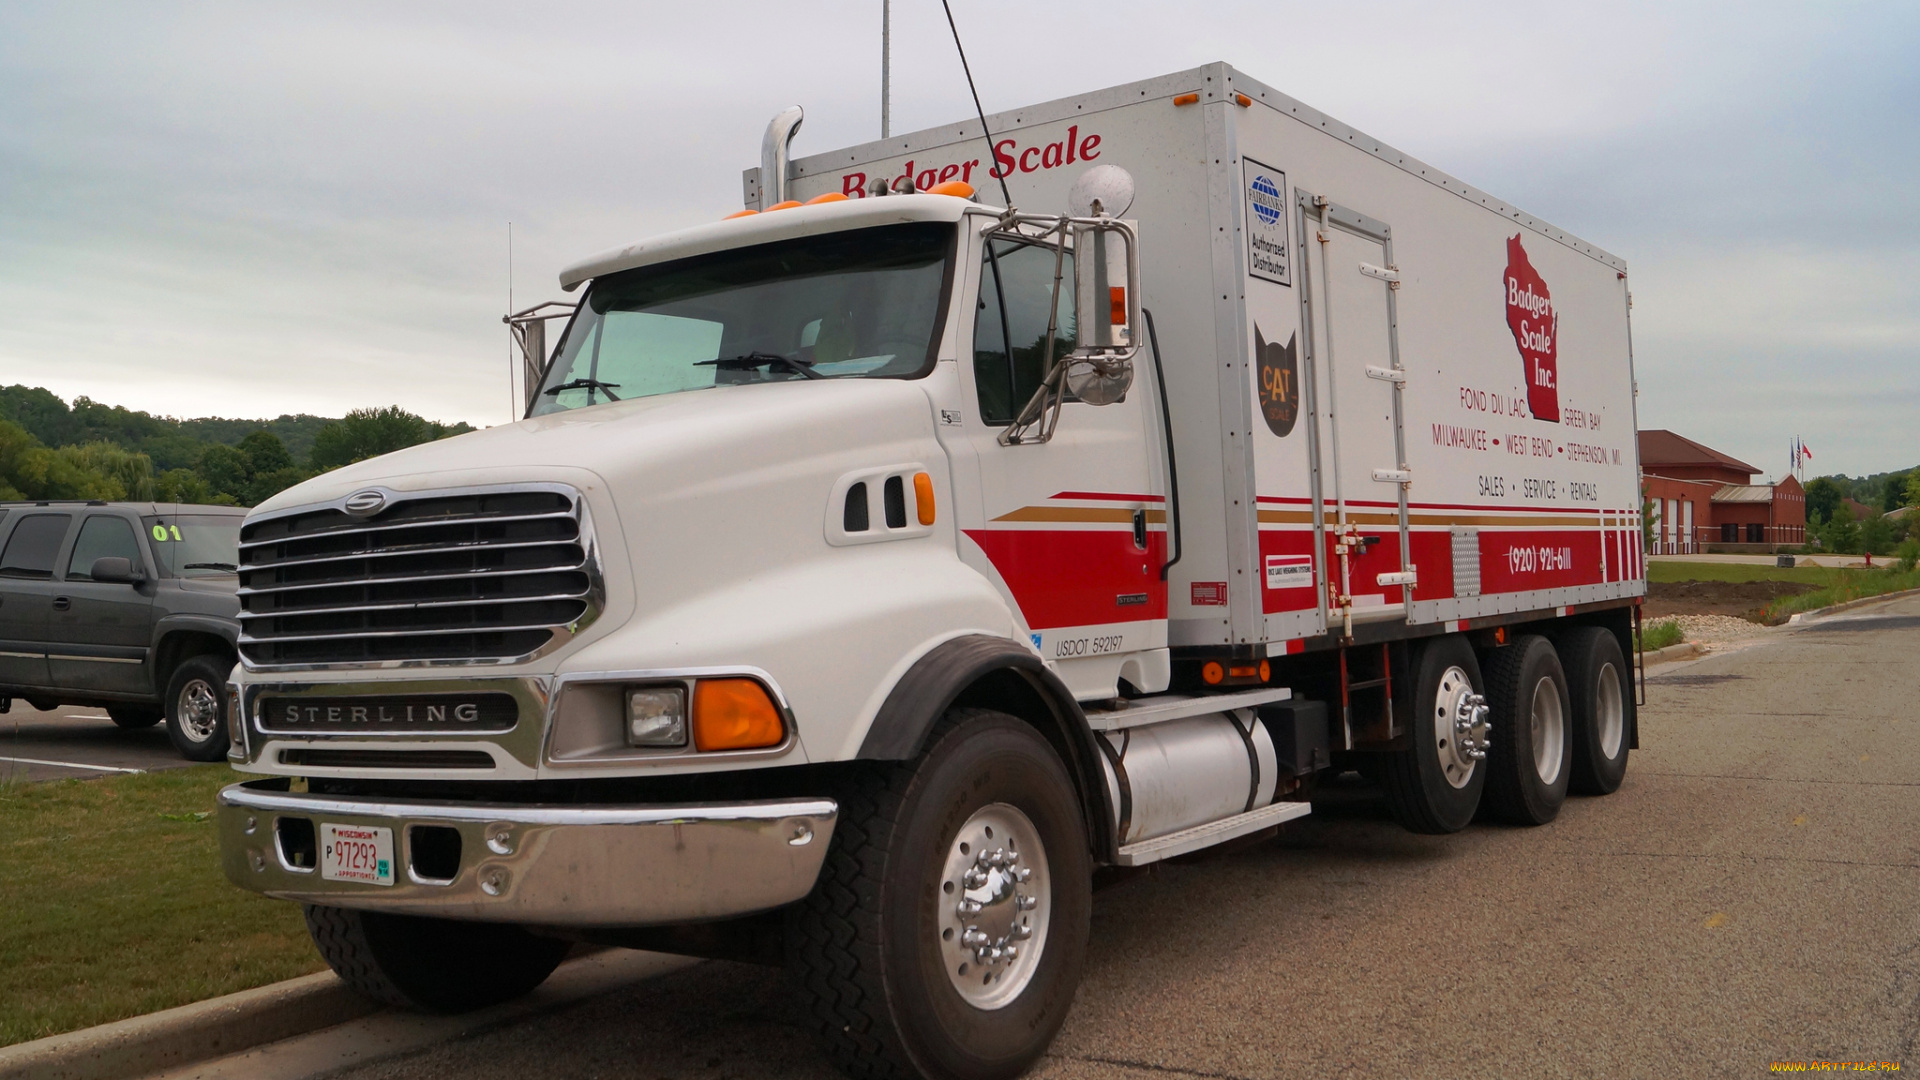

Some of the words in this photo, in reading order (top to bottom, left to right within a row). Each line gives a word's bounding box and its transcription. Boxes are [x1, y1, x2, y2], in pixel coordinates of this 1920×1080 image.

[989, 125, 1101, 178] Scale
[1248, 188, 1284, 212] FAIRBANKS
[1252, 233, 1285, 257] Authorized
[1253, 252, 1285, 276] Distributor
[1508, 276, 1550, 319] Badger
[1521, 319, 1551, 354] Scale
[1262, 365, 1291, 403] CAT
[1534, 357, 1555, 389] Inc.
[1460, 386, 1487, 412] FOND
[1491, 393, 1504, 415] DU
[1508, 397, 1526, 419] LAC
[1564, 408, 1586, 429] GREEN
[1590, 412, 1601, 431] BAY
[1431, 423, 1487, 451] MILWAUKEE
[1505, 433, 1527, 456] WEST
[1532, 437, 1553, 458] BEND
[1478, 475, 1505, 498] SALES
[1523, 478, 1556, 499] SERVICE
[1570, 481, 1597, 501] RENTALS
[152, 525, 182, 542] 01
[1508, 545, 1537, 575] (920)
[1540, 547, 1572, 571] 921-6111
[1119, 594, 1148, 604] STERLING
[1056, 639, 1089, 657] USDOT
[1092, 635, 1123, 654] 592197
[285, 703, 479, 723] STERLING
[338, 830, 373, 840] WISCONSIN
[326, 845, 333, 859] P
[335, 840, 377, 871] 97293
